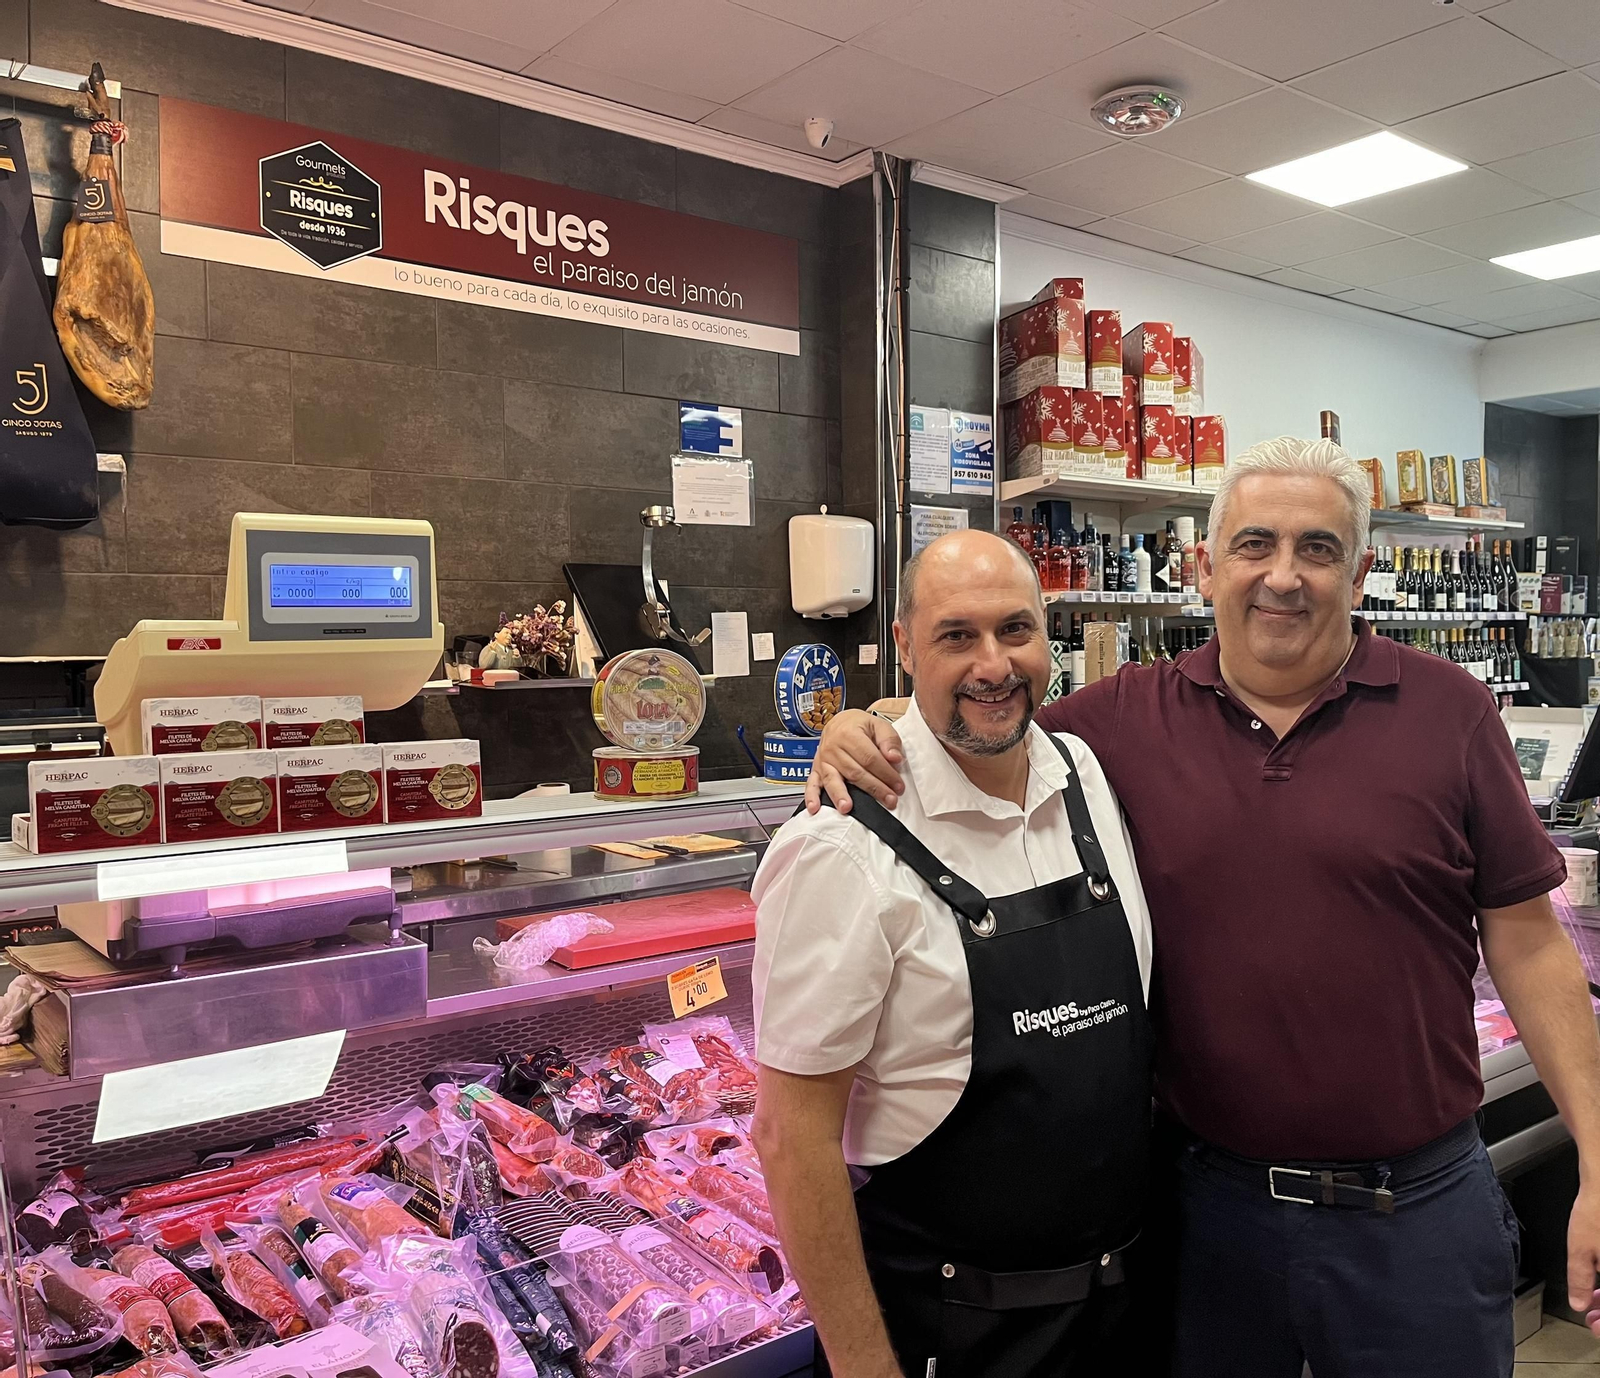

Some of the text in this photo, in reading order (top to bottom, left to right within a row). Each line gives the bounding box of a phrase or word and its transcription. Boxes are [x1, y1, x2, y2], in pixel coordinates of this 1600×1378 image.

[295, 155, 346, 175] Gourmets
[83, 183, 106, 210] 5J
[290, 190, 353, 219] Risques
[424, 169, 610, 257] Risques
[299, 220, 346, 237] desde 1936
[533, 252, 743, 309] el paraiso del jamón
[394, 266, 751, 340] lo bueno para cada día, lo exquisito para las ocasiones.
[12, 363, 49, 415] 5J
[1, 419, 63, 429] CINCO JOTAS
[953, 458, 991, 467] VIDEOVIGILADA
[980, 472, 991, 480] 945
[300, 568, 329, 577] codigo
[793, 647, 840, 689] BALEA
[636, 699, 671, 719] LOLA
[779, 682, 792, 721] BALEA
[160, 708, 199, 716] HERPAC
[172, 765, 213, 774] HERPAC
[287, 758, 324, 766] HERPAC
[781, 767, 811, 777] BALE
[45, 772, 88, 781] HERPAC
[1012, 999, 1116, 1036] Risques by Paco Castro
[1052, 1002, 1129, 1037] el paraiso del jamón
